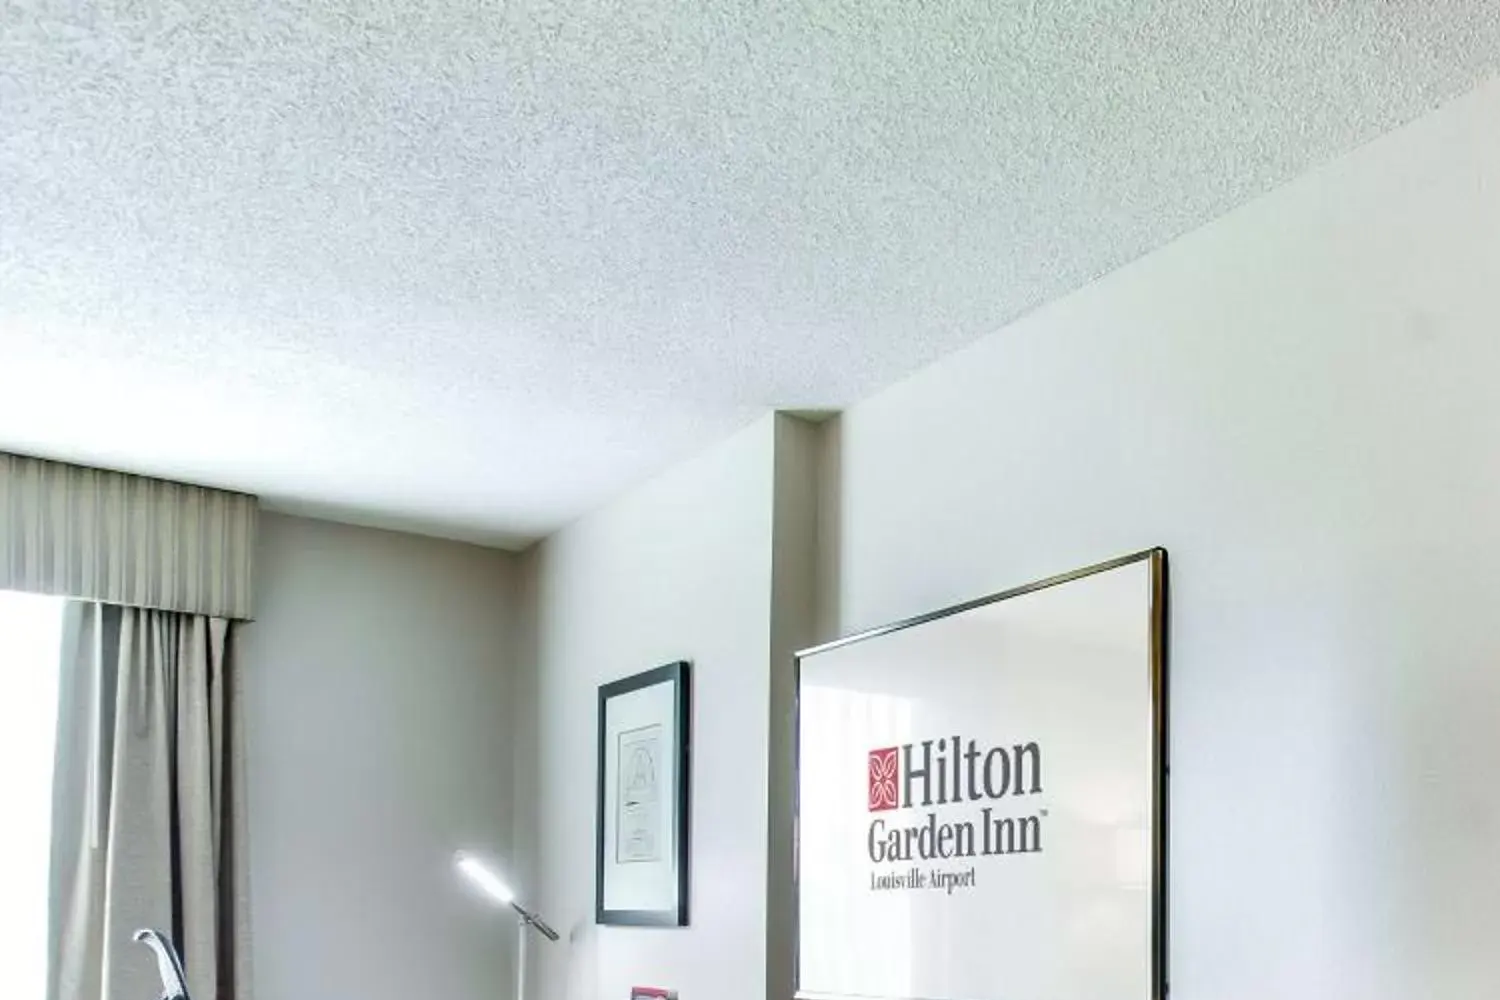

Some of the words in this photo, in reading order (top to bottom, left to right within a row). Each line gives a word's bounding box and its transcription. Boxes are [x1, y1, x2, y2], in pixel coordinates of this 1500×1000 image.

[902, 736, 1043, 808] Hilton
[868, 813, 976, 863] Garden
[980, 807, 1043, 855] Inn
[870, 867, 926, 891] Louisville
[928, 866, 976, 895] Airport
